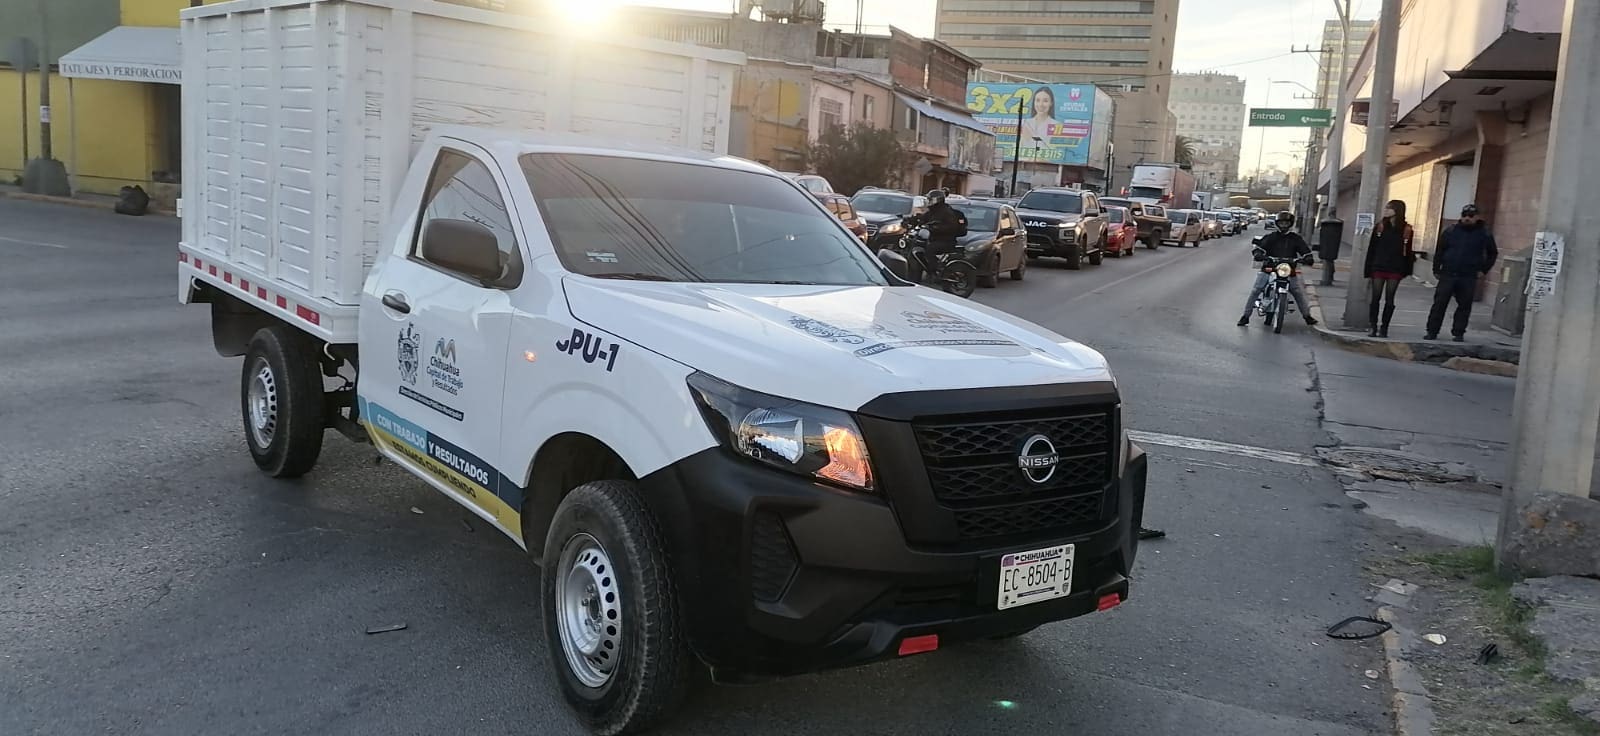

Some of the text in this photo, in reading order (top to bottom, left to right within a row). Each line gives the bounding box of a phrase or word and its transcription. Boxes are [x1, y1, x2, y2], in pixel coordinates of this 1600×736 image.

[62, 63, 105, 75] TATUAJES
[105, 65, 111, 75] Y
[967, 86, 1033, 115] 3x2
[1251, 112, 1286, 120] Entrada
[1025, 220, 1047, 228] JAC
[430, 355, 460, 377] Chihuahua
[377, 414, 489, 485] CON TRABAJO Y RESULTADOS
[1020, 455, 1059, 466] NISSAN
[1020, 549, 1059, 562] CHIHUAHUA
[1003, 558, 1072, 593] EC-8504-B
